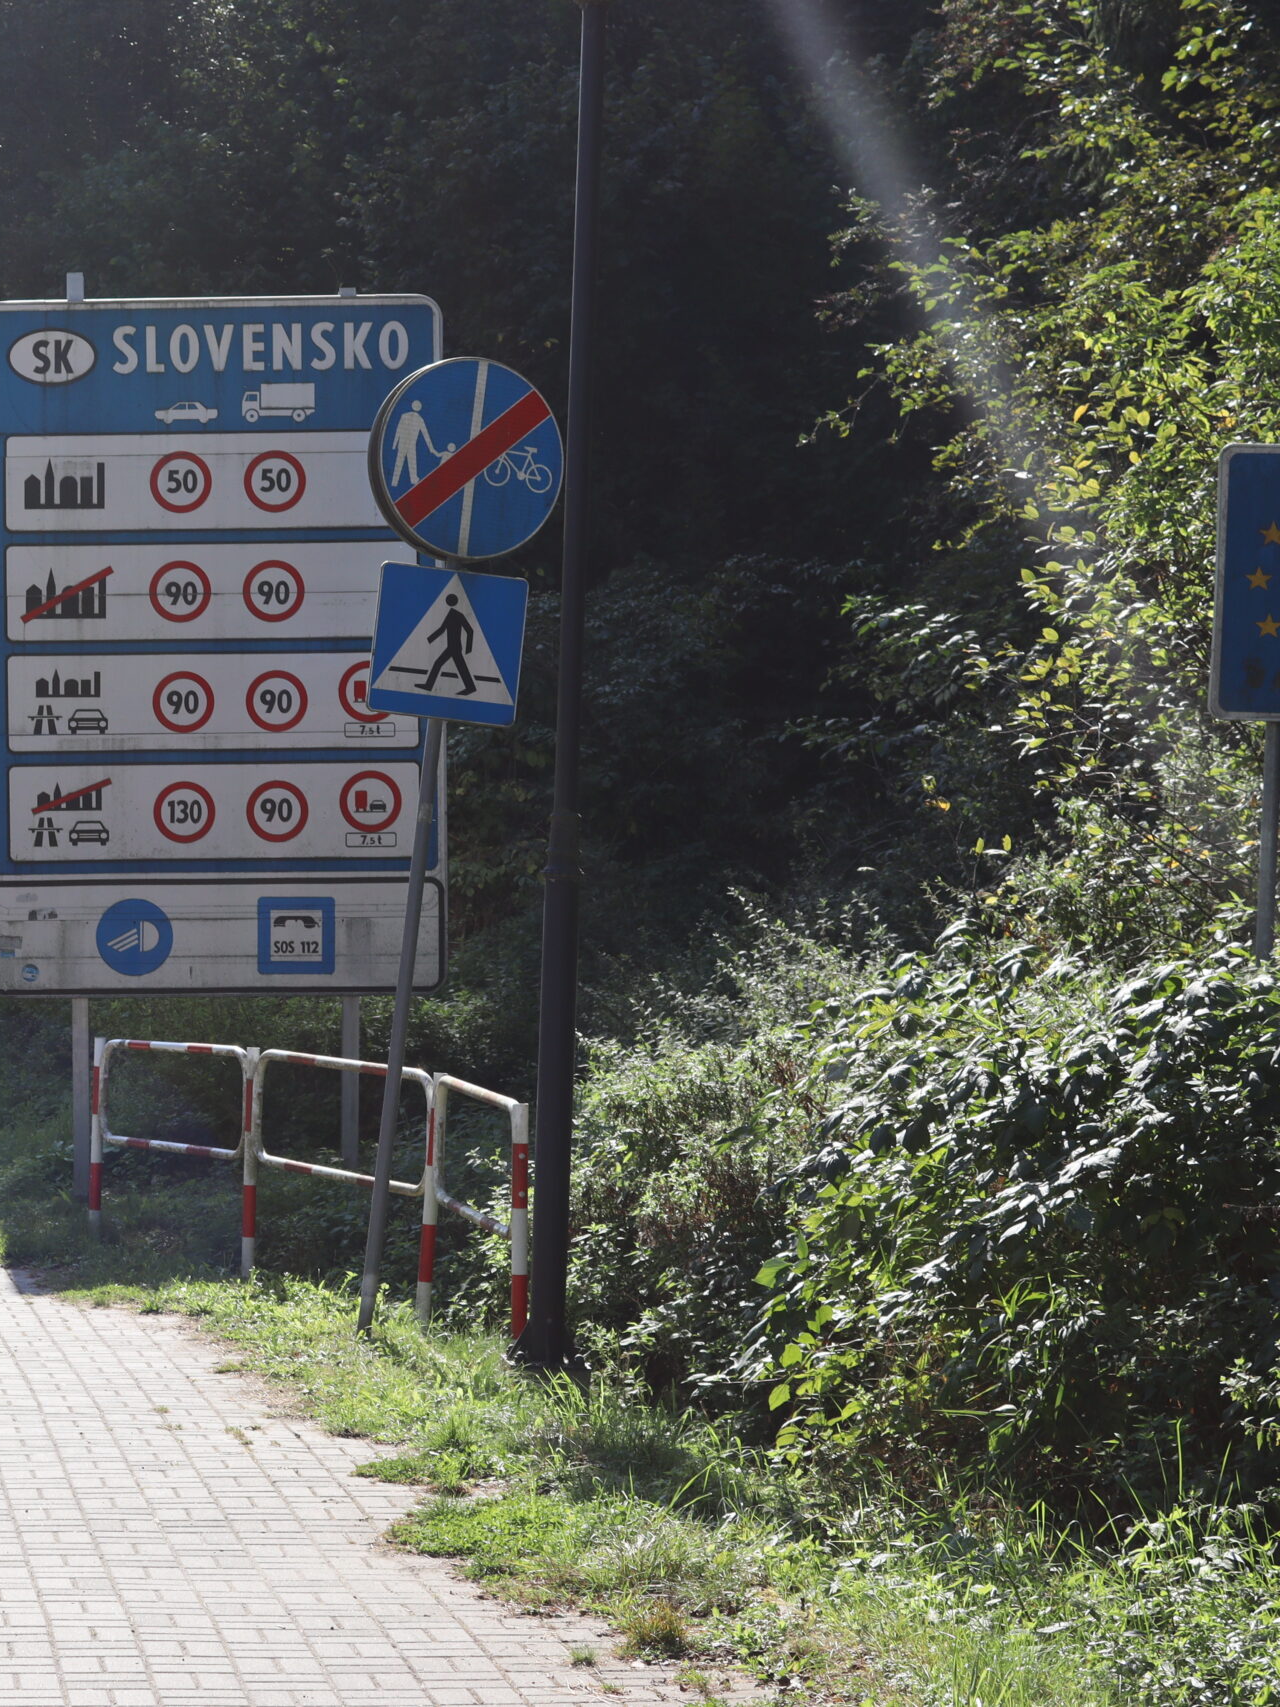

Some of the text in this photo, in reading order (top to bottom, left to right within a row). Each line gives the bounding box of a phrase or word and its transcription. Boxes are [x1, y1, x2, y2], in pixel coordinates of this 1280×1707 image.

[33, 339, 74, 374] SK
[112, 320, 409, 374] SLOVENSKO
[166, 469, 198, 493] 50
[260, 468, 291, 492] 50
[165, 581, 197, 605] 90
[257, 580, 290, 605] 90
[166, 690, 199, 714] 90
[259, 689, 292, 713] 90
[167, 800, 202, 824] 130
[260, 798, 293, 822] 90
[273, 940, 320, 954] SOS 112
